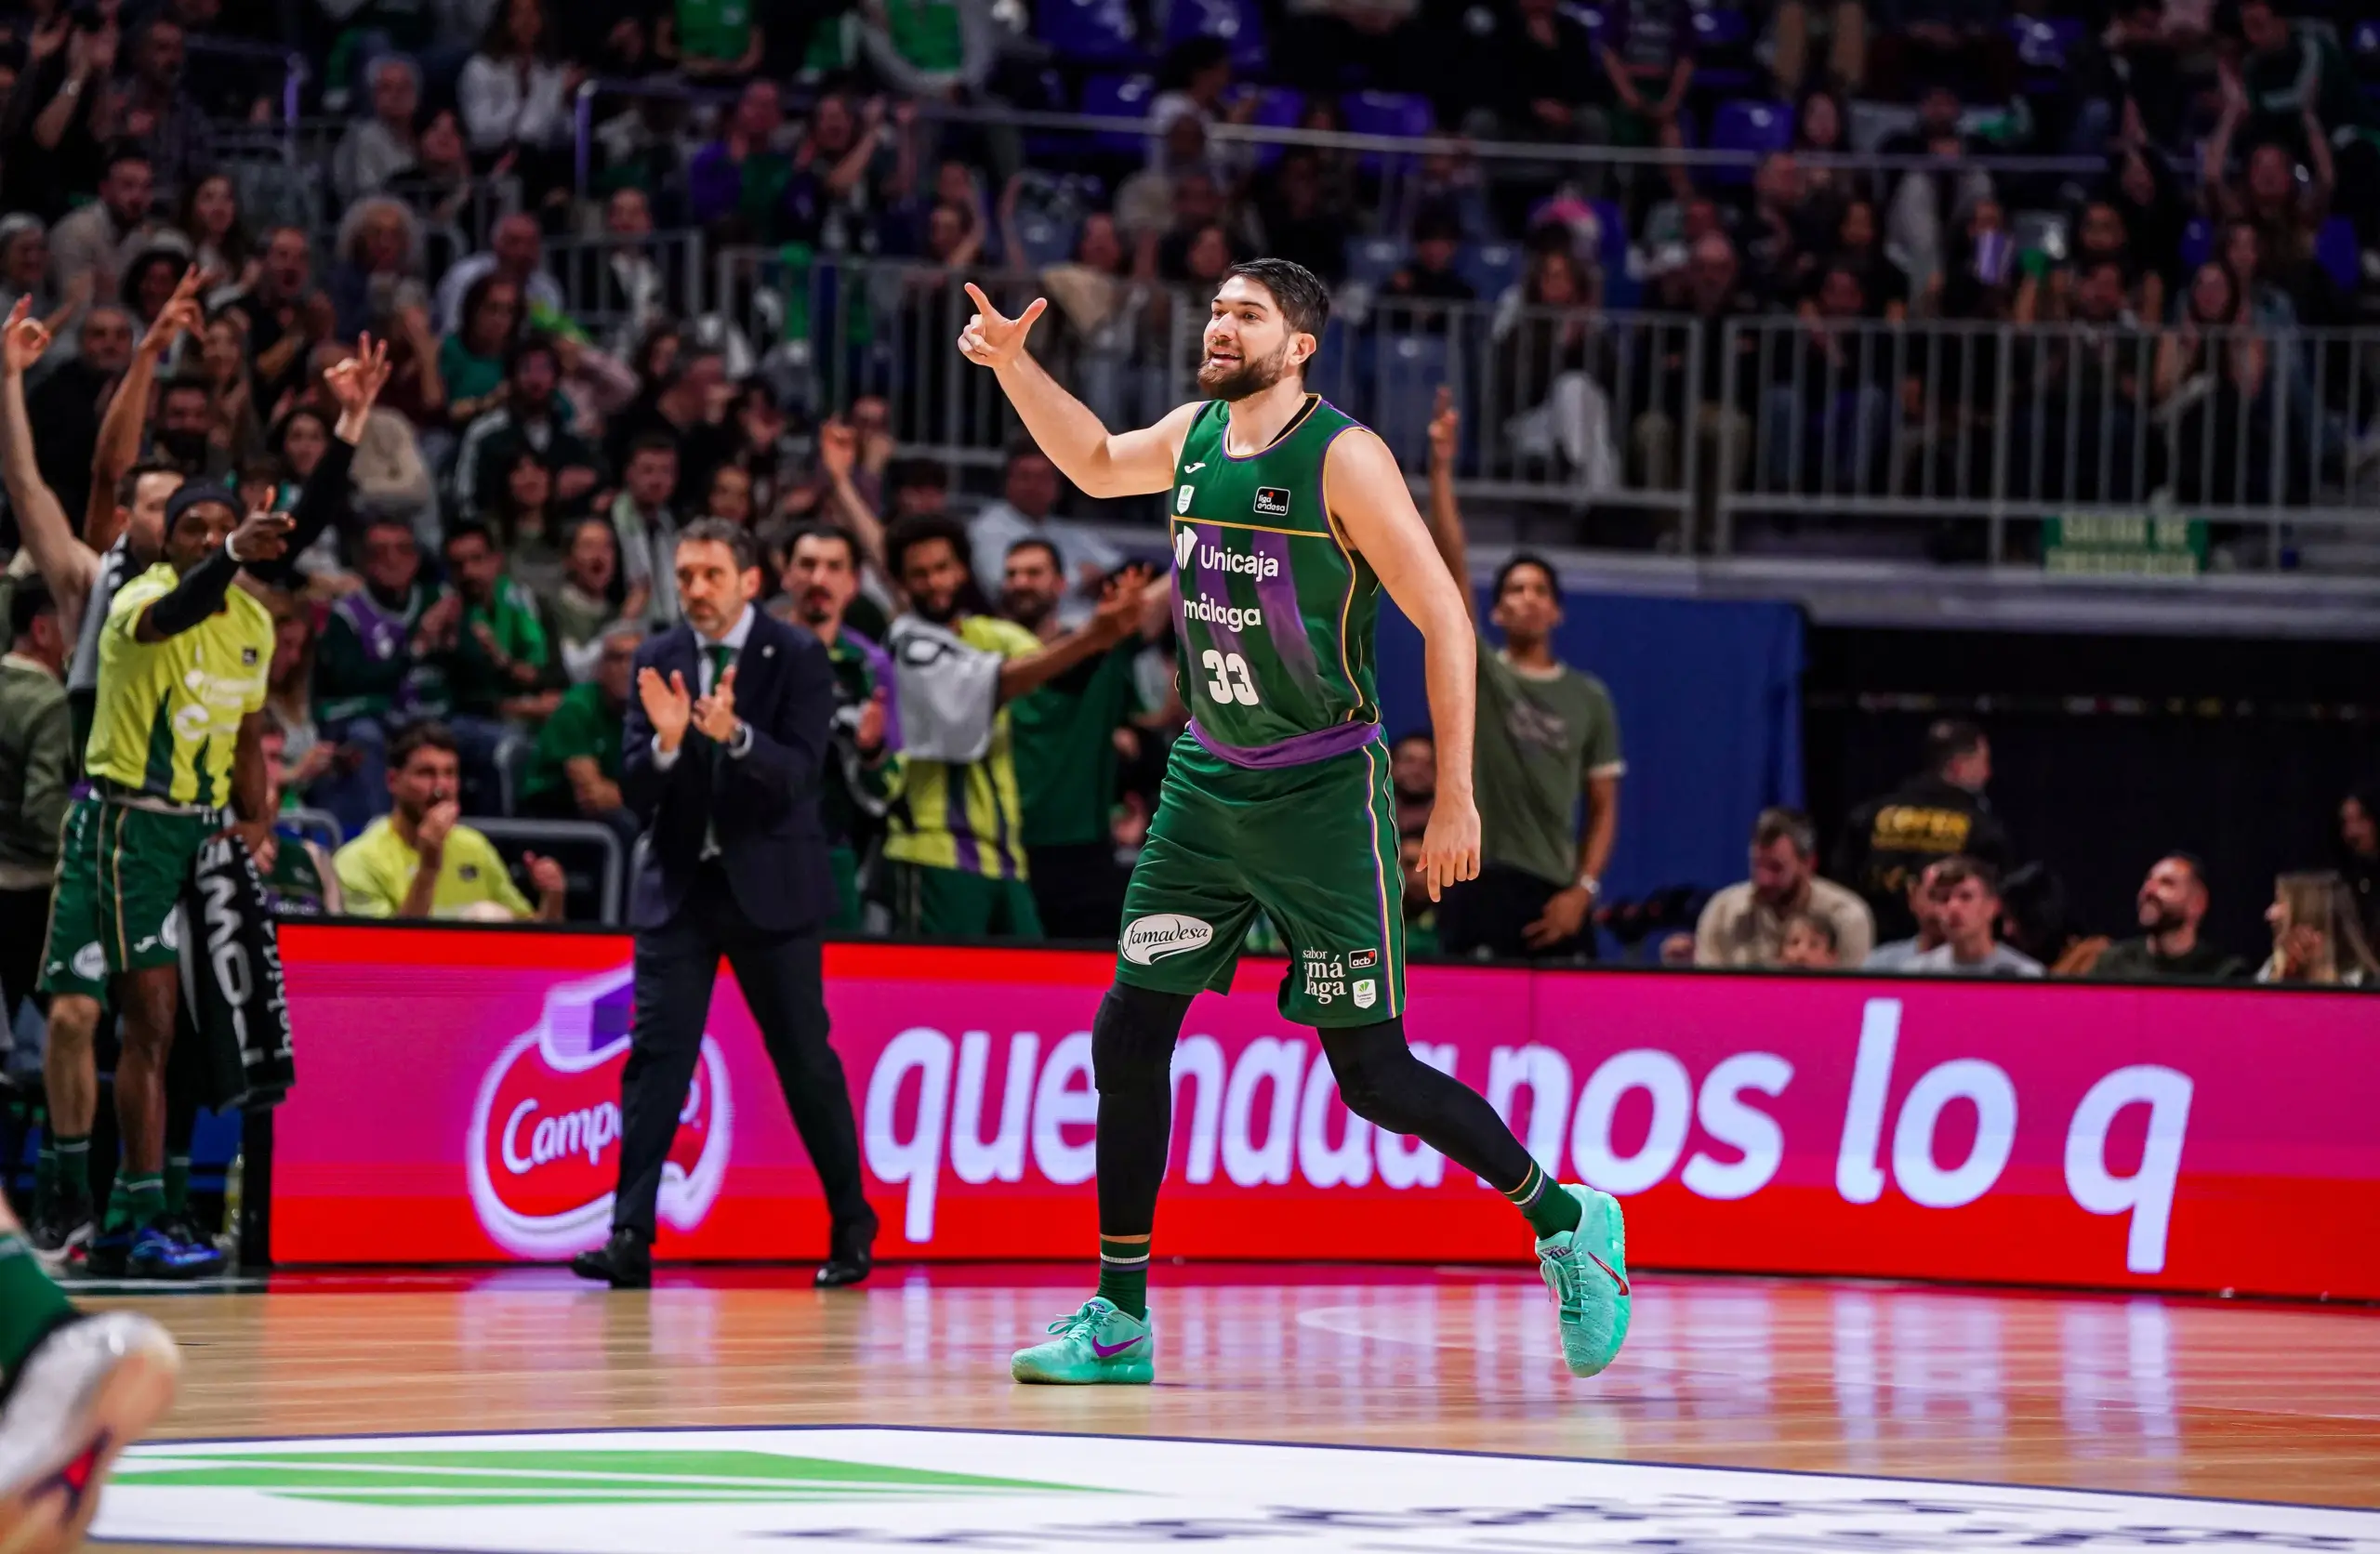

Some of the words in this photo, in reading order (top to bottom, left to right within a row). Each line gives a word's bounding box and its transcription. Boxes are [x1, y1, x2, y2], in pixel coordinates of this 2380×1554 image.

[1257, 503, 1286, 512] endesa
[1259, 494, 1272, 504] liga
[1200, 544, 1279, 583] Unicaja
[1202, 650, 1260, 705] 33
[1125, 917, 1209, 952] famadesa
[1302, 946, 1328, 959] sabor
[1352, 956, 1371, 967] acb
[1303, 973, 1347, 1005] laga
[502, 1099, 624, 1175] Camp
[863, 1027, 1098, 1244] que
[1476, 1040, 1795, 1201] nos
[1835, 997, 2018, 1209] lo
[2064, 1063, 2195, 1274] q
